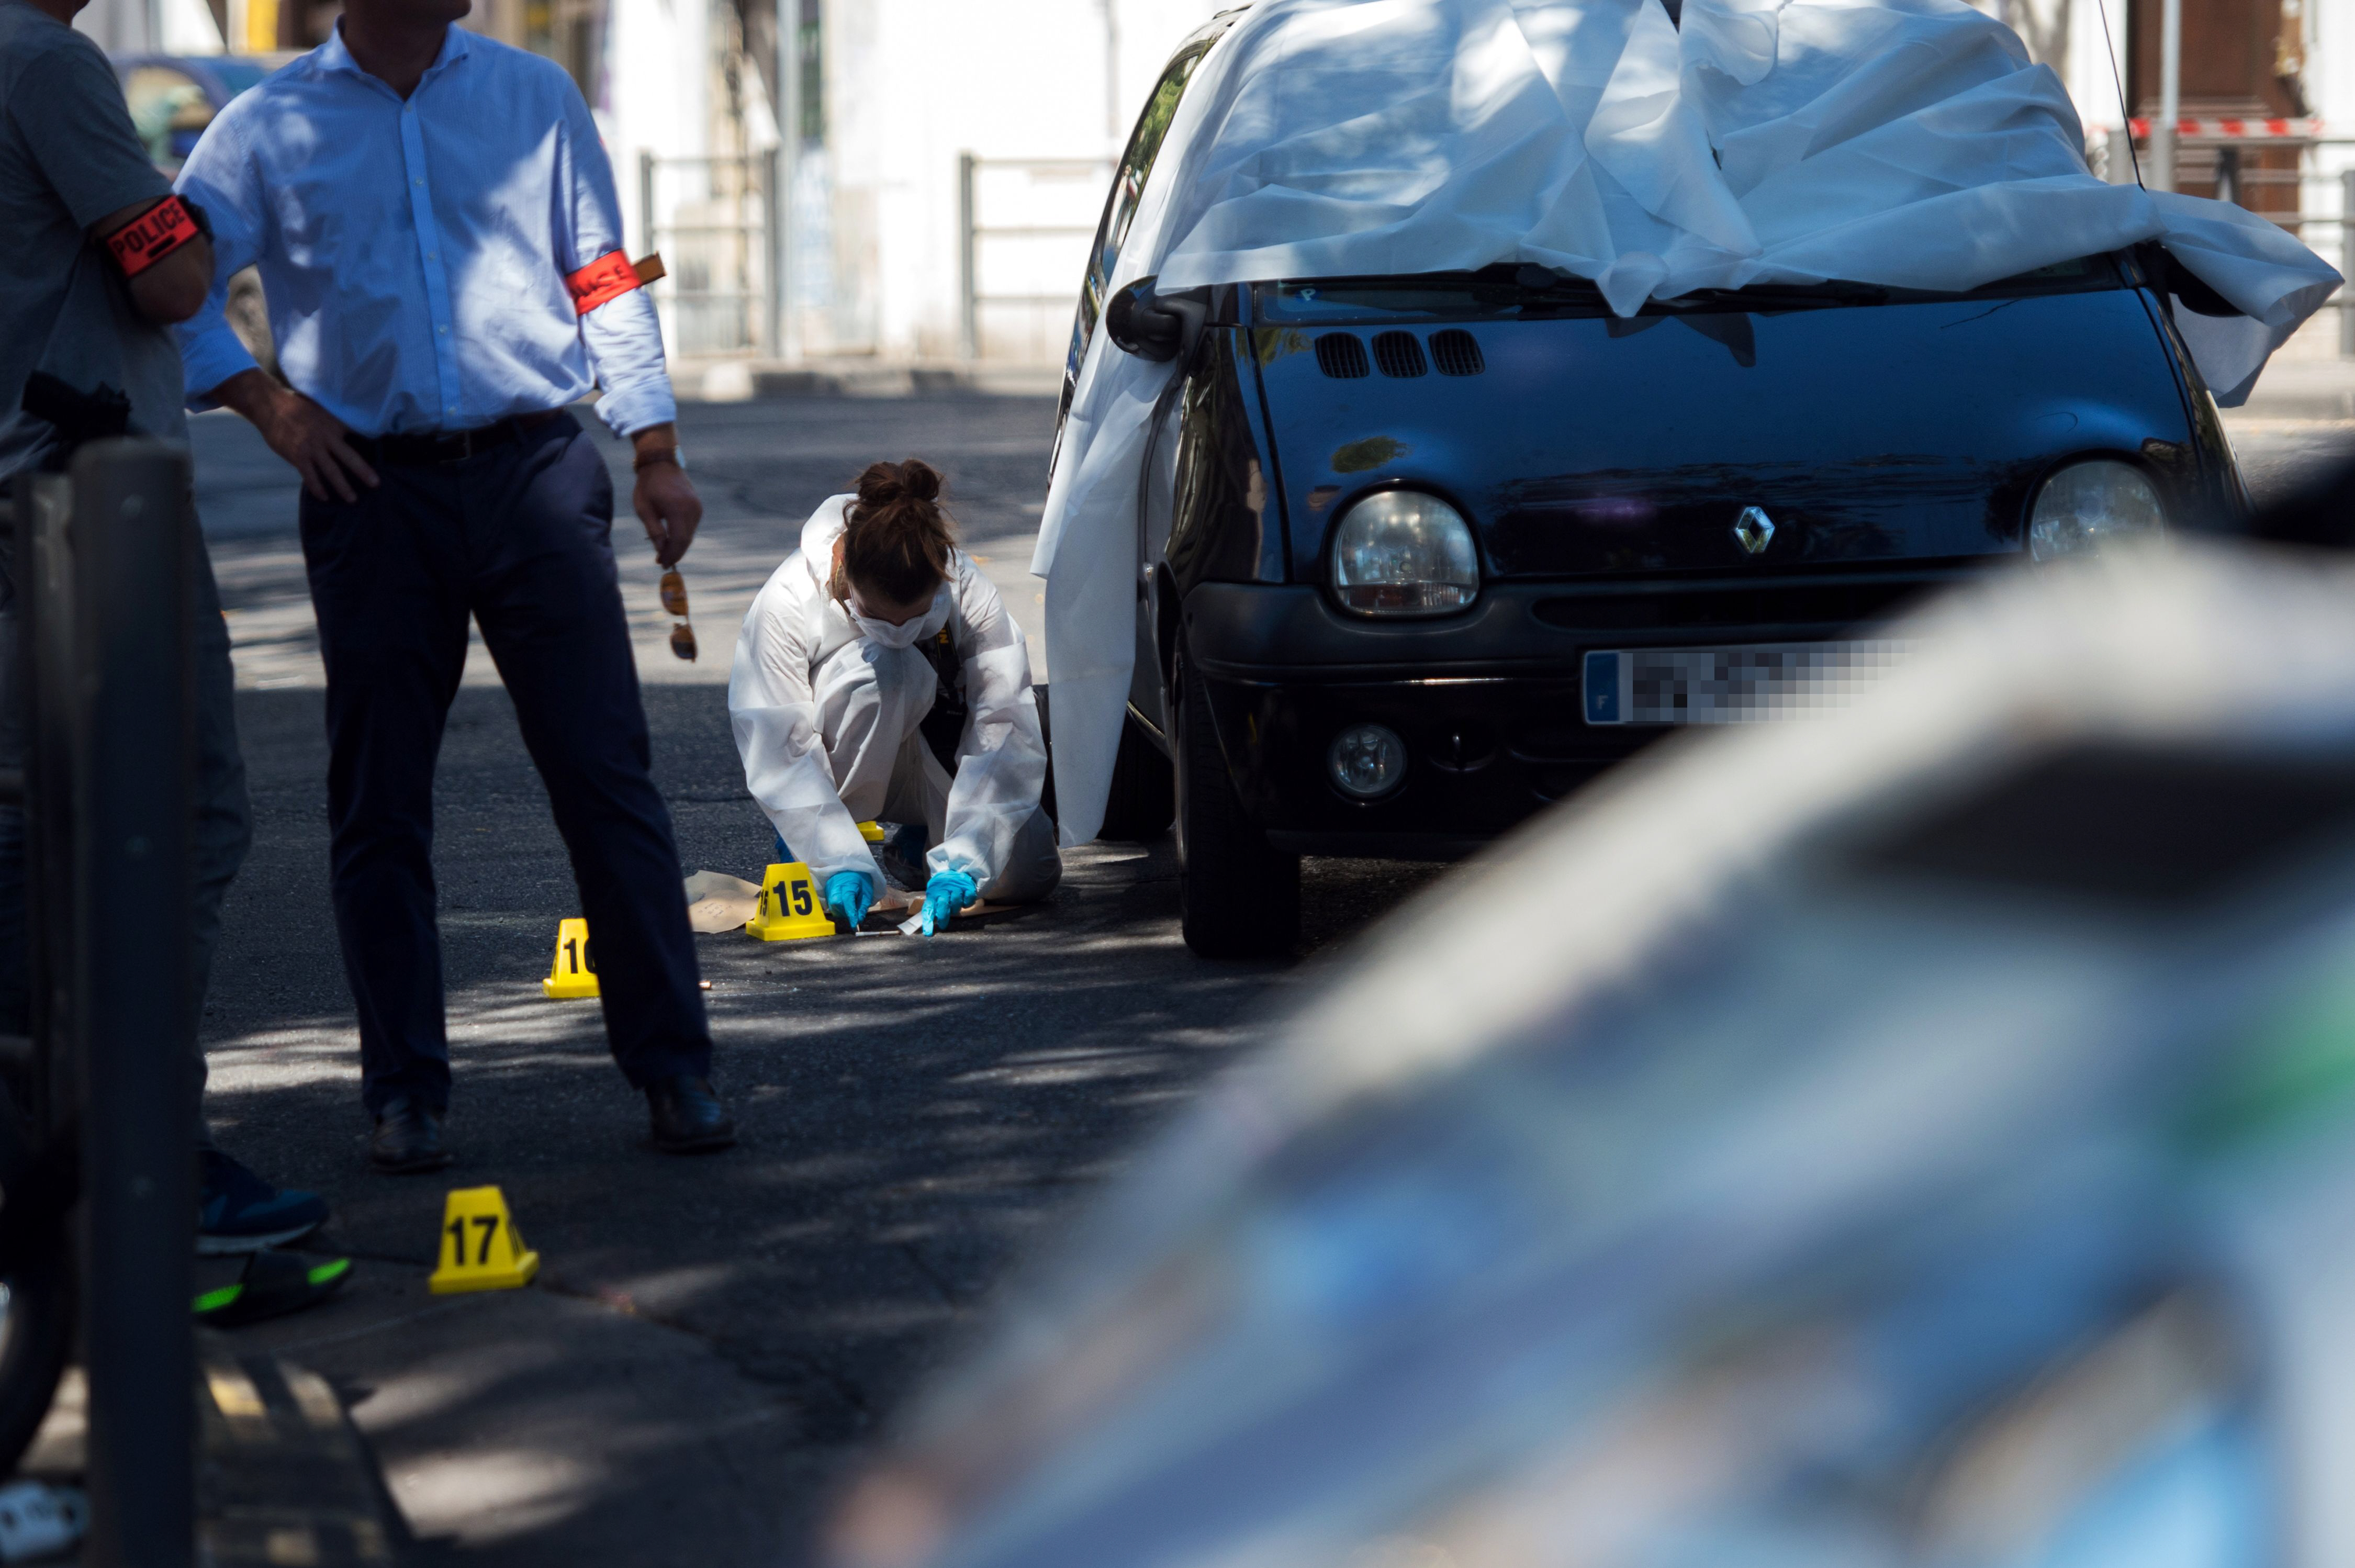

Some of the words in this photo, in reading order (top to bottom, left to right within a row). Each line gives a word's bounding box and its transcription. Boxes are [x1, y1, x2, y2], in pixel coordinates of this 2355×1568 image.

[111, 203, 185, 261] POLICE
[1597, 695, 1608, 710] F
[773, 880, 813, 916] 15
[446, 1215, 499, 1267] 17
